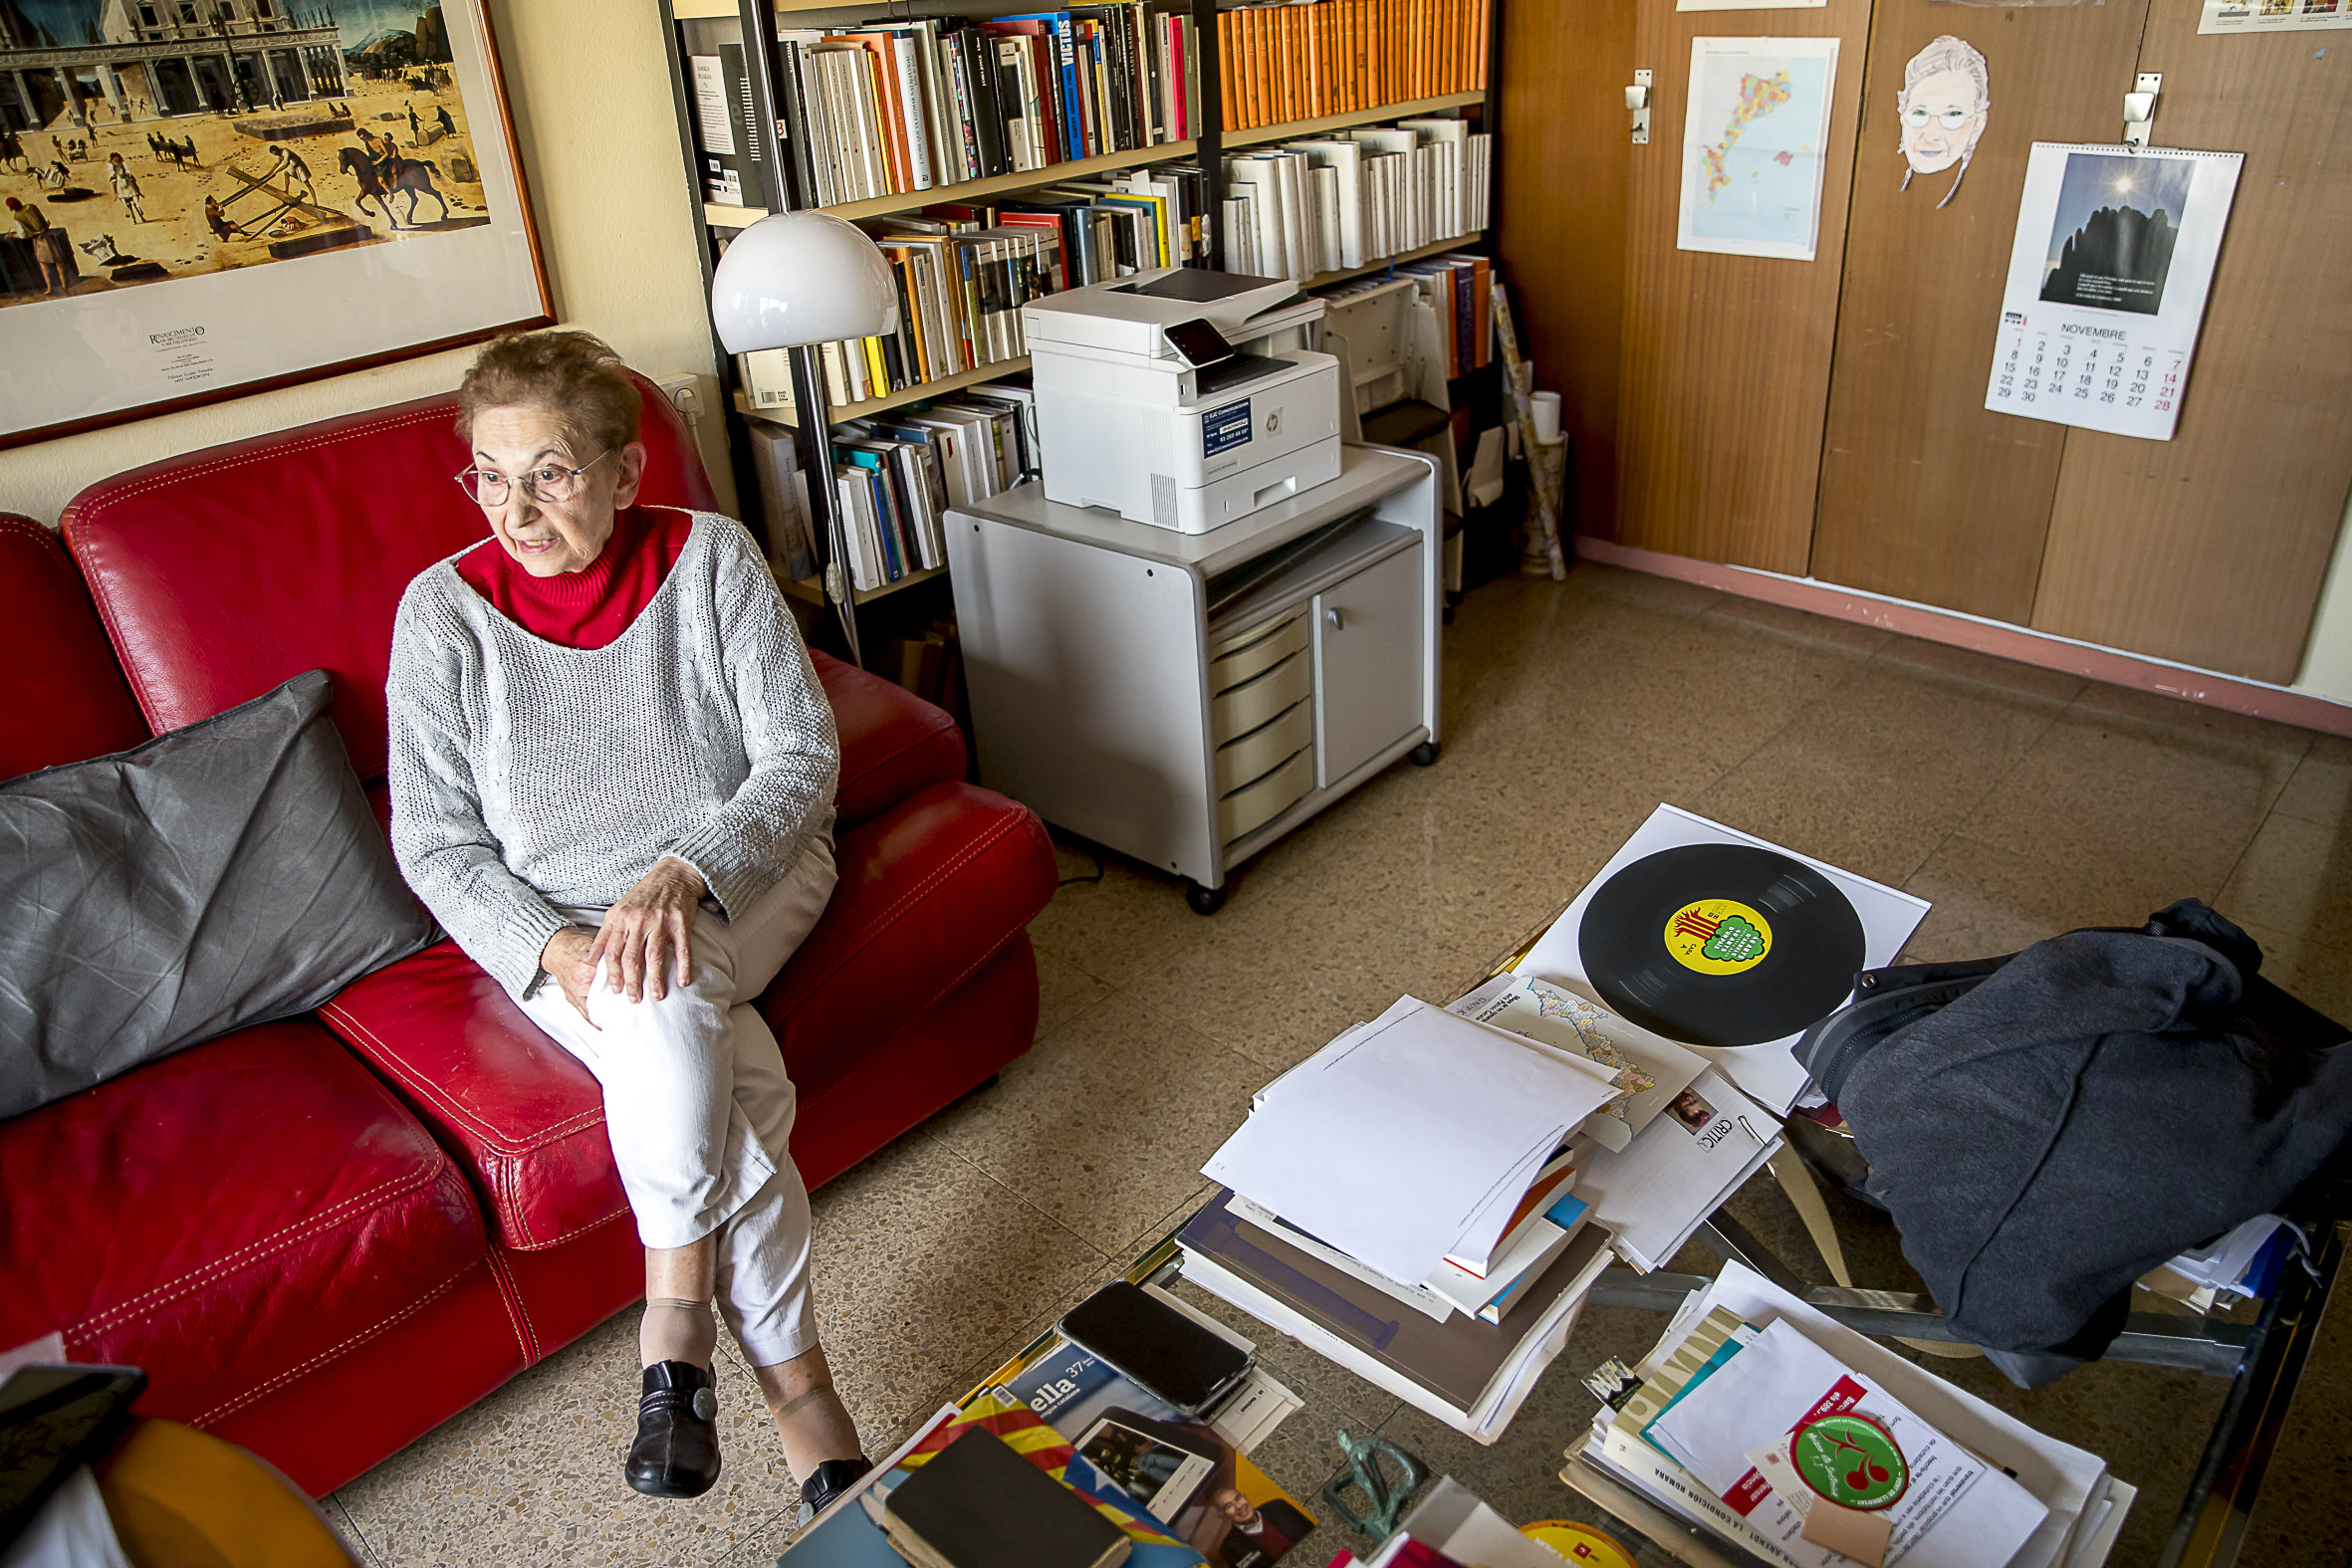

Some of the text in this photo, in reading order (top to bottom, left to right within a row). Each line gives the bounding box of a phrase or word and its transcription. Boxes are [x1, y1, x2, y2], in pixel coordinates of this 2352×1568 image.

[1057, 18, 1073, 66] VICTUS
[2061, 324, 2127, 340] NOVEMBRE
[2017, 337, 2181, 369] 1 2 3 4 5 6 7
[2010, 349, 2177, 383] 8 9 10 11 12 13 14
[2004, 361, 2175, 397] 15 16 17 18 19 20 21
[1998, 386, 2035, 402] 29 30
[1999, 374, 2171, 412] 22 23 24 25 26 27 28
[1684, 943, 1697, 956] CARA
[1721, 937, 1735, 952] ANYS
[1738, 944, 1753, 960] ANYS
[1030, 1361, 1083, 1412] ella 37
[1829, 1392, 1840, 1402] els
[1890, 1417, 1902, 1427] Som
[1954, 1465, 1963, 1476] que
[1951, 1470, 1974, 1497] transversal
[1856, 1494, 1889, 1505] LLIBERTAT
[1887, 1487, 1896, 1497] DE
[1943, 1496, 1952, 1506] que
[1655, 1468, 1781, 1556] ARENDT LA CONDICIÓN HUMANA
